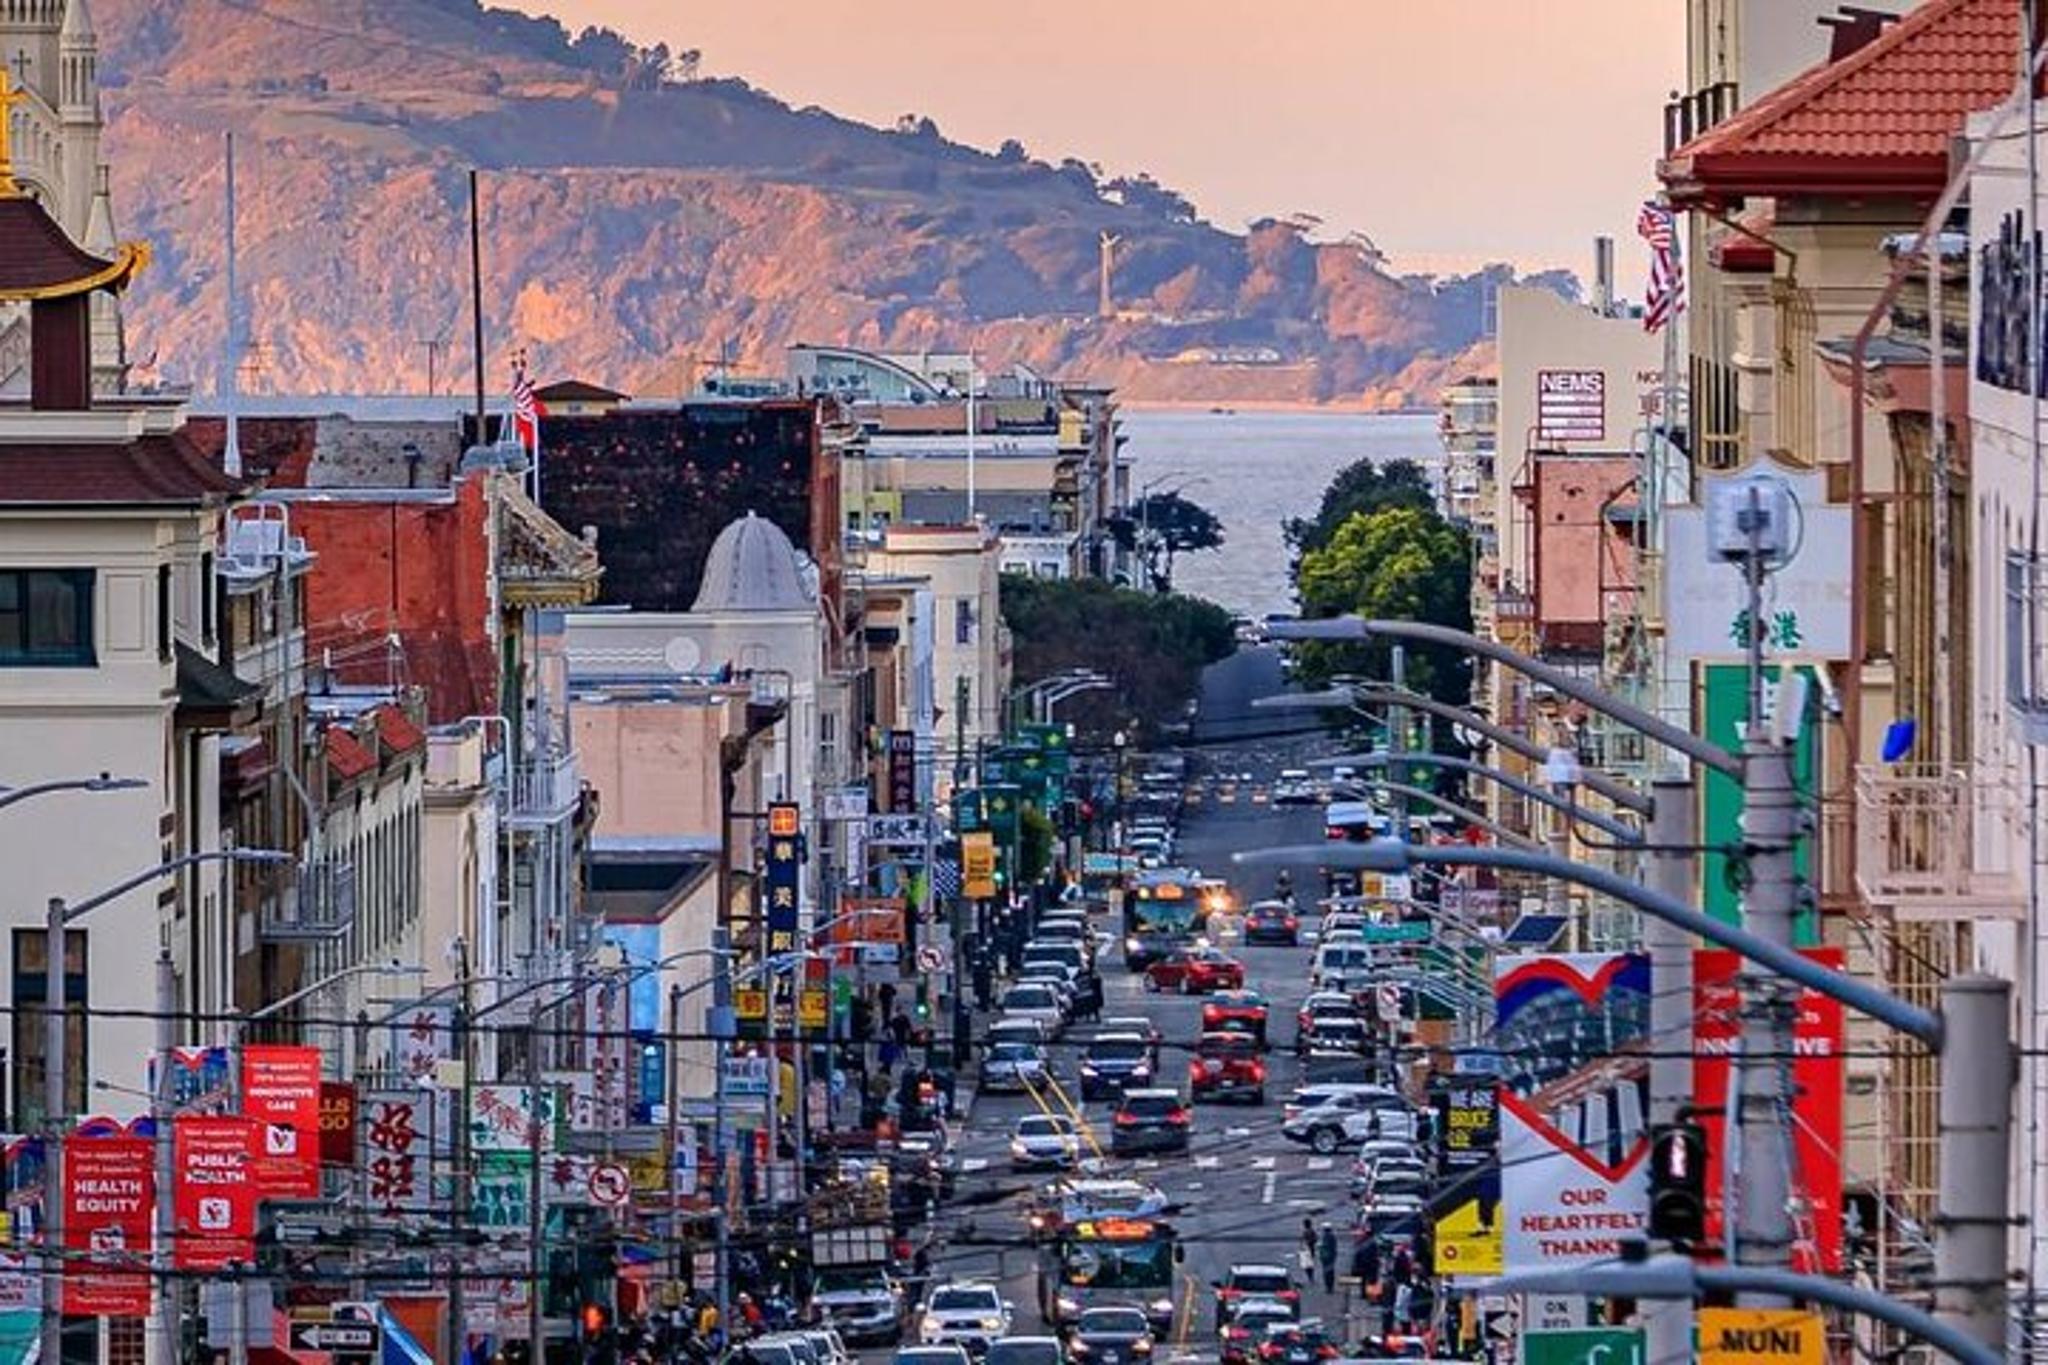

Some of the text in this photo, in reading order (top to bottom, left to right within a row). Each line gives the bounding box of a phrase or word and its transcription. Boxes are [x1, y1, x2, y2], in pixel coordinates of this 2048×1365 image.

[1541, 373, 1602, 392] NEMS
[73, 1180, 142, 1195] HEALTH
[76, 1199, 140, 1213] EQUITY
[1560, 1188, 1608, 1206] OUR
[1520, 1212, 1645, 1232] HEARTFELT
[1539, 1238, 1620, 1256] THANK
[1720, 1328, 1800, 1354] MUNI
